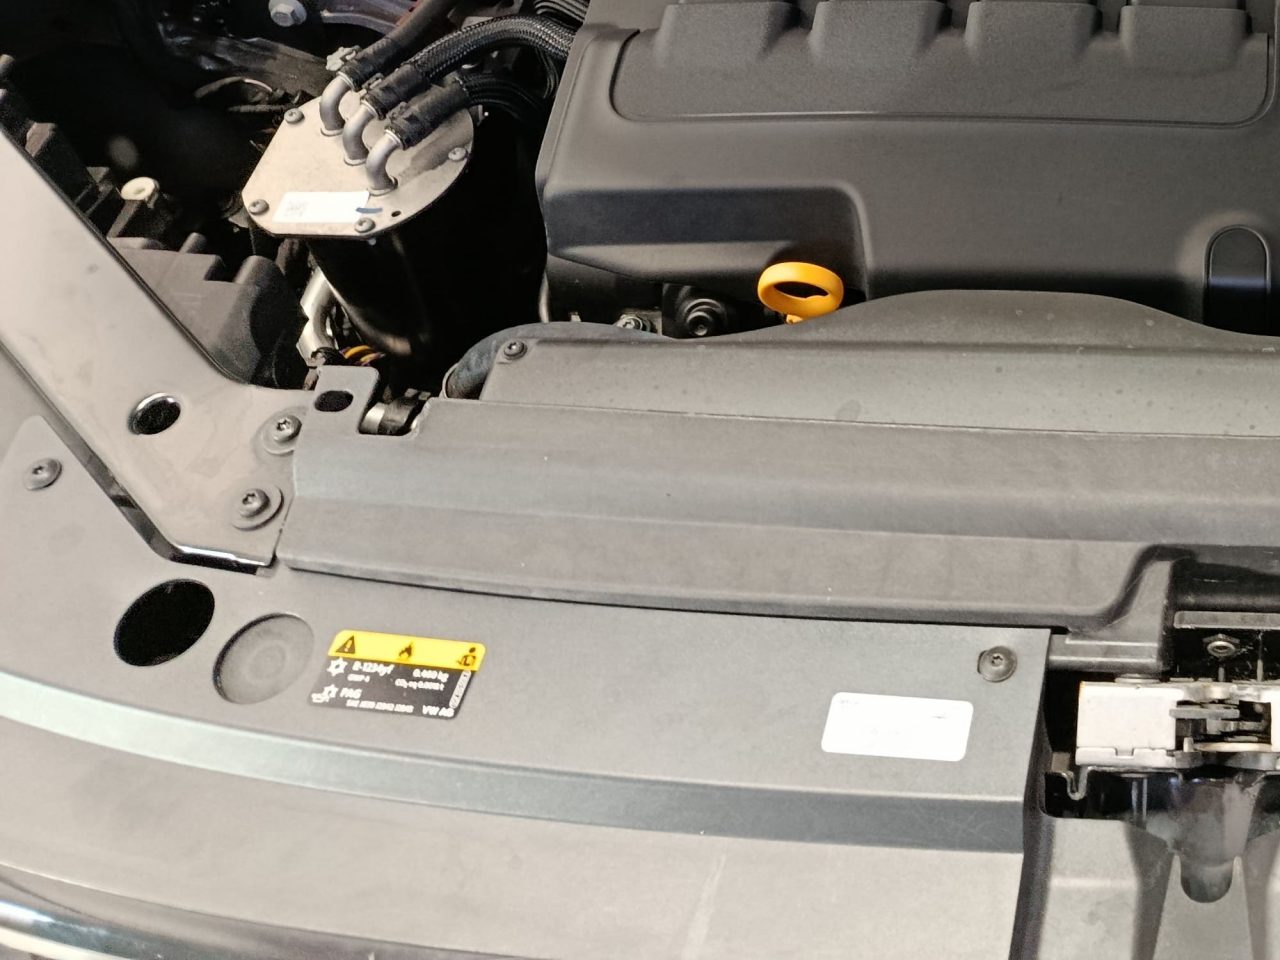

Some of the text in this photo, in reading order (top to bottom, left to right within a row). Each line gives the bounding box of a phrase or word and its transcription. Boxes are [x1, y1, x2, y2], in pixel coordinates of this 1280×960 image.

[340, 687, 363, 699] PAG
[422, 704, 439, 716] VW
[438, 706, 455, 718] AG
